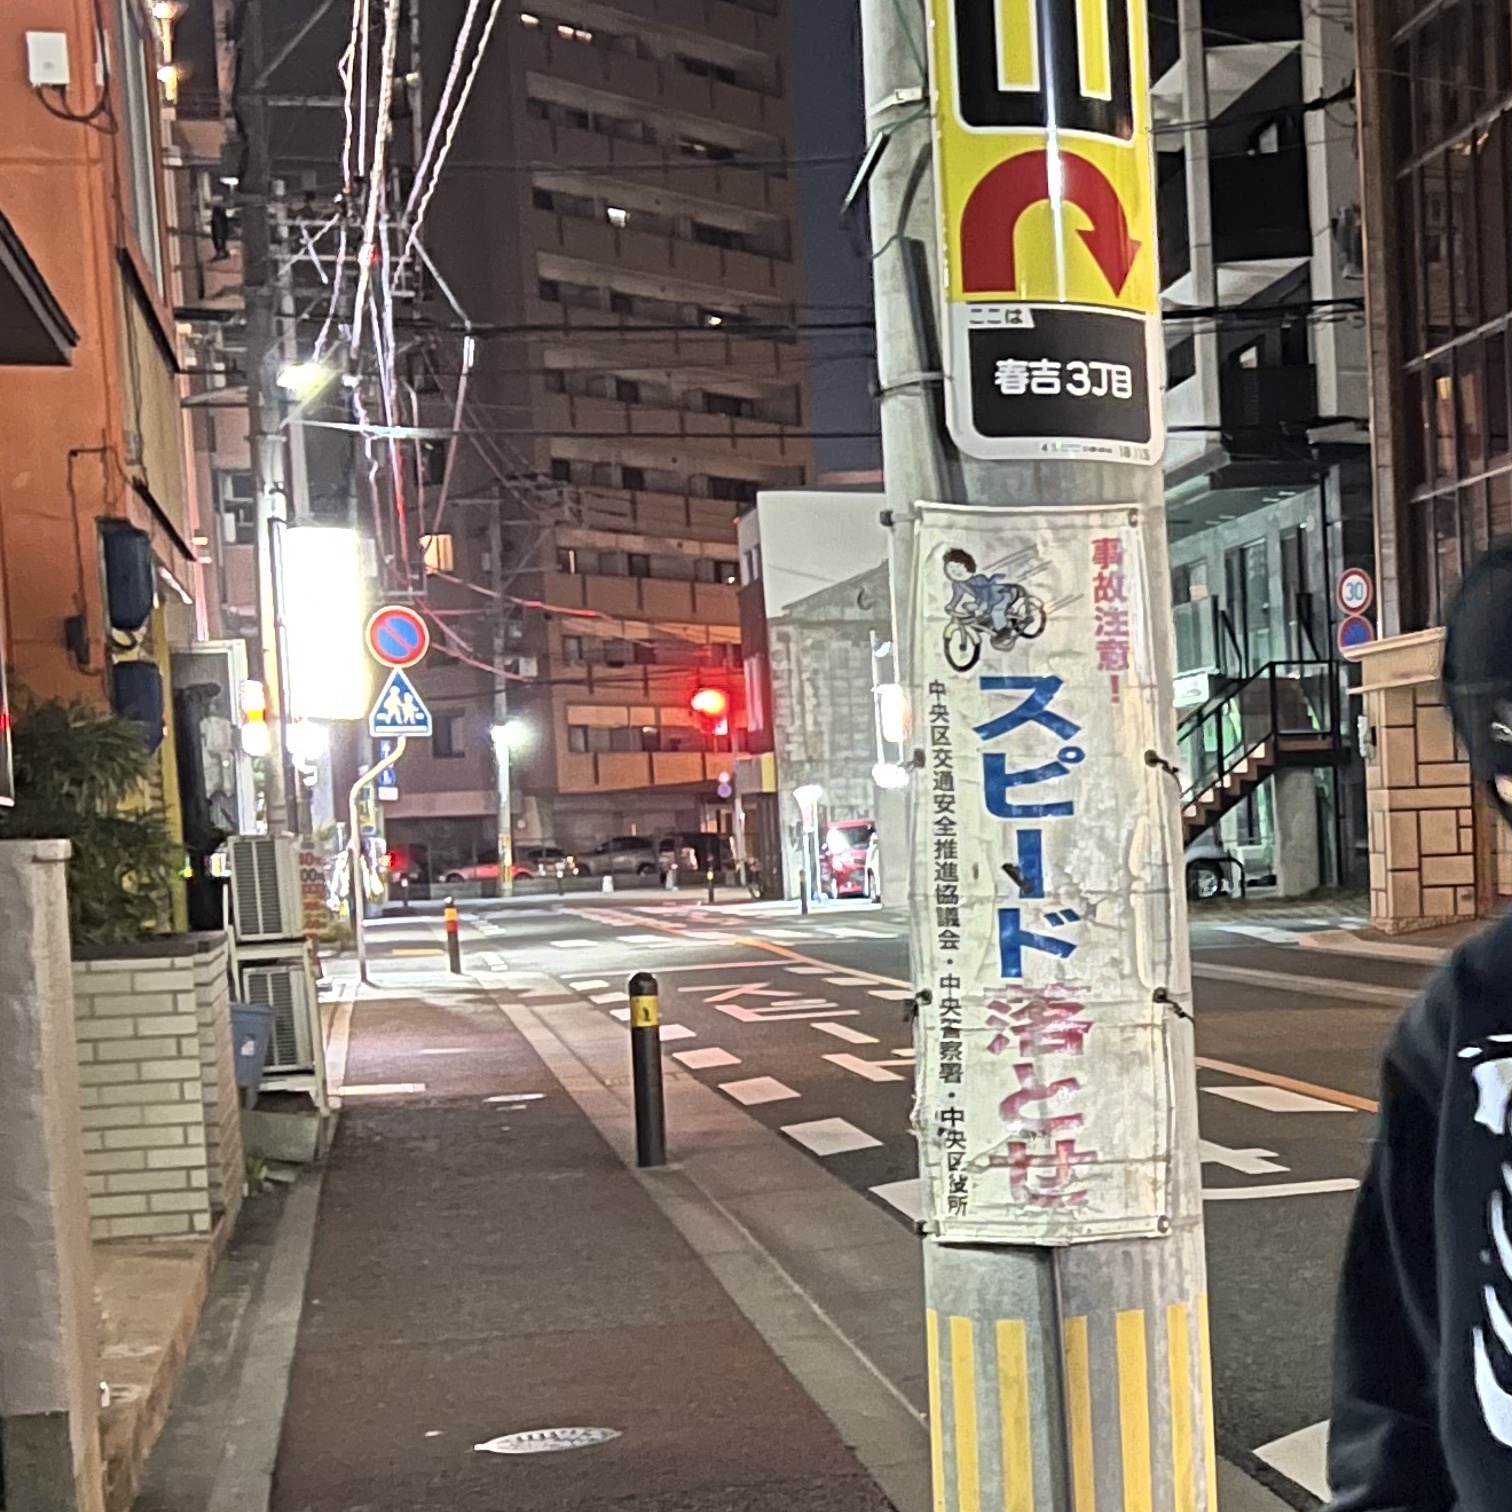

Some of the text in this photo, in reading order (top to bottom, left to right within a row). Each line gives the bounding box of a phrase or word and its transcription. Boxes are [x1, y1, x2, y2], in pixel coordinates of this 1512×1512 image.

[969, 308, 1023, 325] ここは
[994, 357, 1133, 399] 春吉3丁目
[1345, 582, 1364, 602] 30
[1091, 537, 1130, 704] 事故注意!
